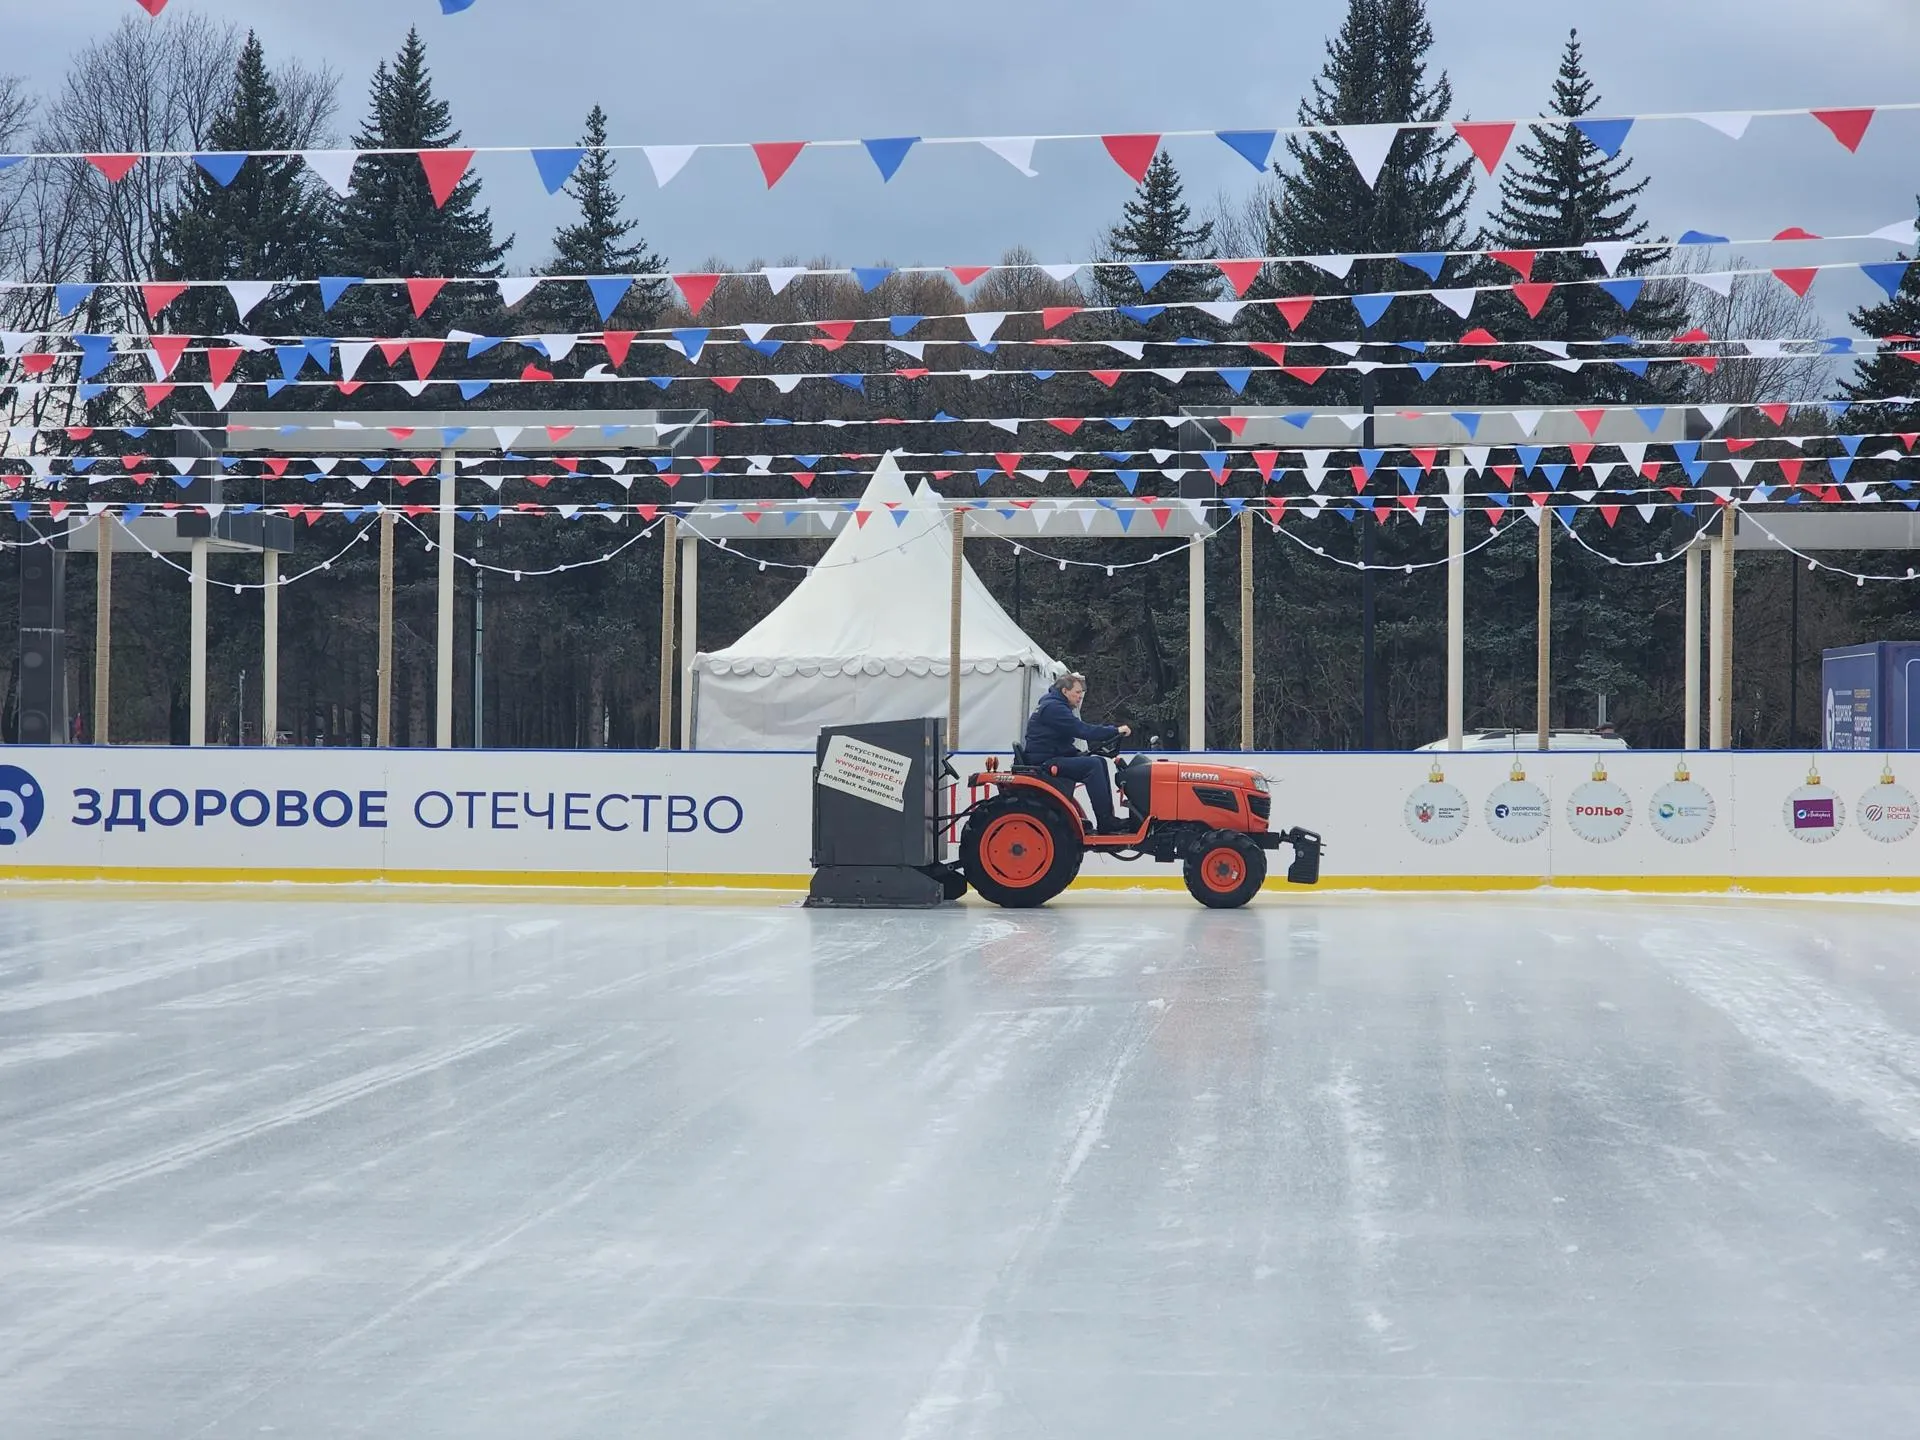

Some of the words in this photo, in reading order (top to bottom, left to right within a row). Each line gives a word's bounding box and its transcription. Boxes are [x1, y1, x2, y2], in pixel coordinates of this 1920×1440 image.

[843, 752, 877, 767] ледовые
[879, 764, 901, 775] катки
[845, 743, 904, 767] искусственные
[823, 772, 857, 787] ледовых
[835, 758, 904, 786] www.pifagorICE.ru
[838, 768, 865, 782] сервис
[867, 778, 895, 792] аренда
[1181, 771, 1220, 781] KUBOTA
[71, 788, 388, 832] ЗДОРОВОЕ
[414, 790, 744, 834] ОТЕЧЕСТВО
[1576, 806, 1624, 816] РОЛЬФ
